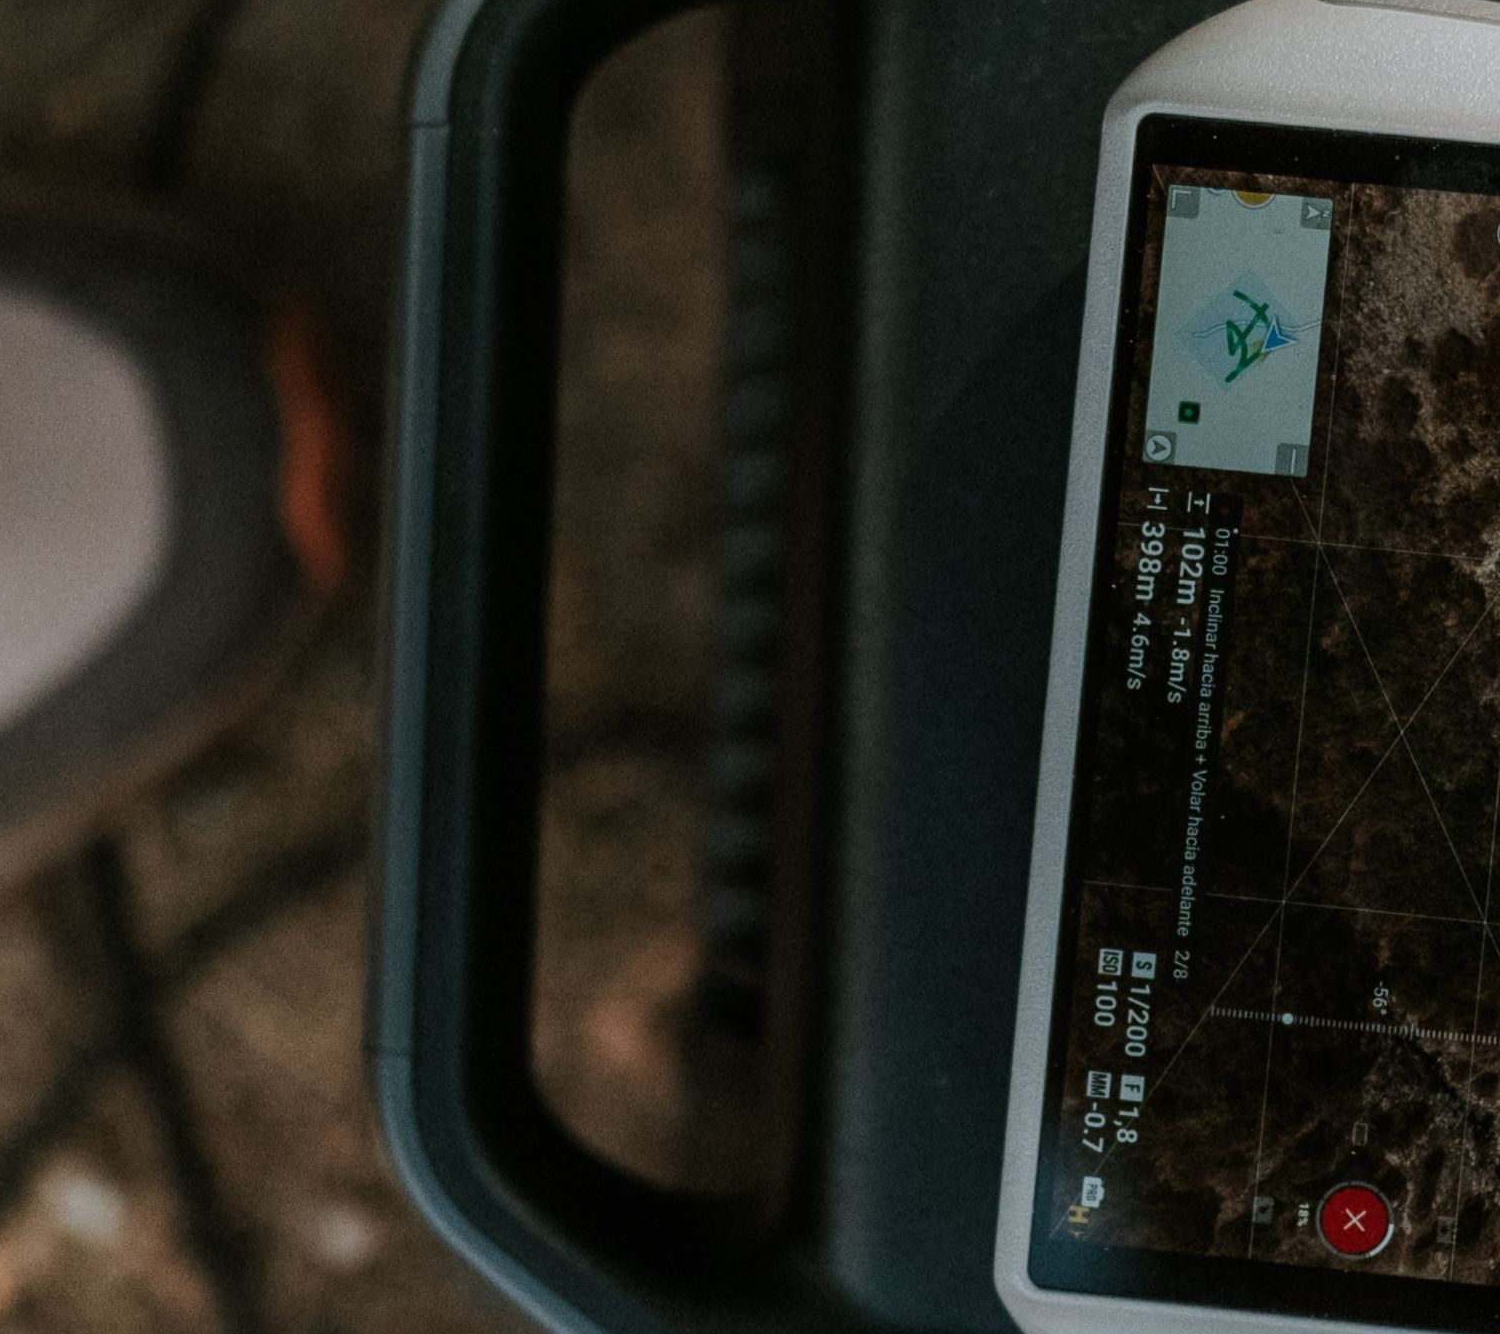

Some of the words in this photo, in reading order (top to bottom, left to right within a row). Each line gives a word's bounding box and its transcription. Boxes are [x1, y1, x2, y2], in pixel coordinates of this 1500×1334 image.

[1135, 521, 1166, 601] 398m
[1176, 526, 1205, 605] 102m
[1211, 527, 1231, 576] 01:00
[1205, 588, 1225, 649] Inclinar
[1127, 612, 1151, 691] 4.6m/s
[1167, 616, 1193, 704] -1.8m/s
[1200, 653, 1219, 697] hacia
[1195, 702, 1213, 750] arriba
[1194, 754, 1206, 765] +
[1189, 770, 1208, 812] Volar
[1184, 816, 1203, 860] hacia
[1176, 864, 1198, 937] adelante
[1101, 951, 1120, 974] ISO
[1136, 961, 1152, 971] S
[1172, 949, 1189, 980] 2/8
[1093, 980, 1117, 1027] 100
[1124, 984, 1151, 1057] 1/200
[1089, 1073, 1108, 1097] MM
[1125, 1084, 1140, 1093] F
[1082, 1102, 1105, 1152] -0.7
[1115, 1107, 1140, 1144] 1,8
[1085, 1183, 1099, 1202] PRO
[1297, 1202, 1309, 1227] 18%
